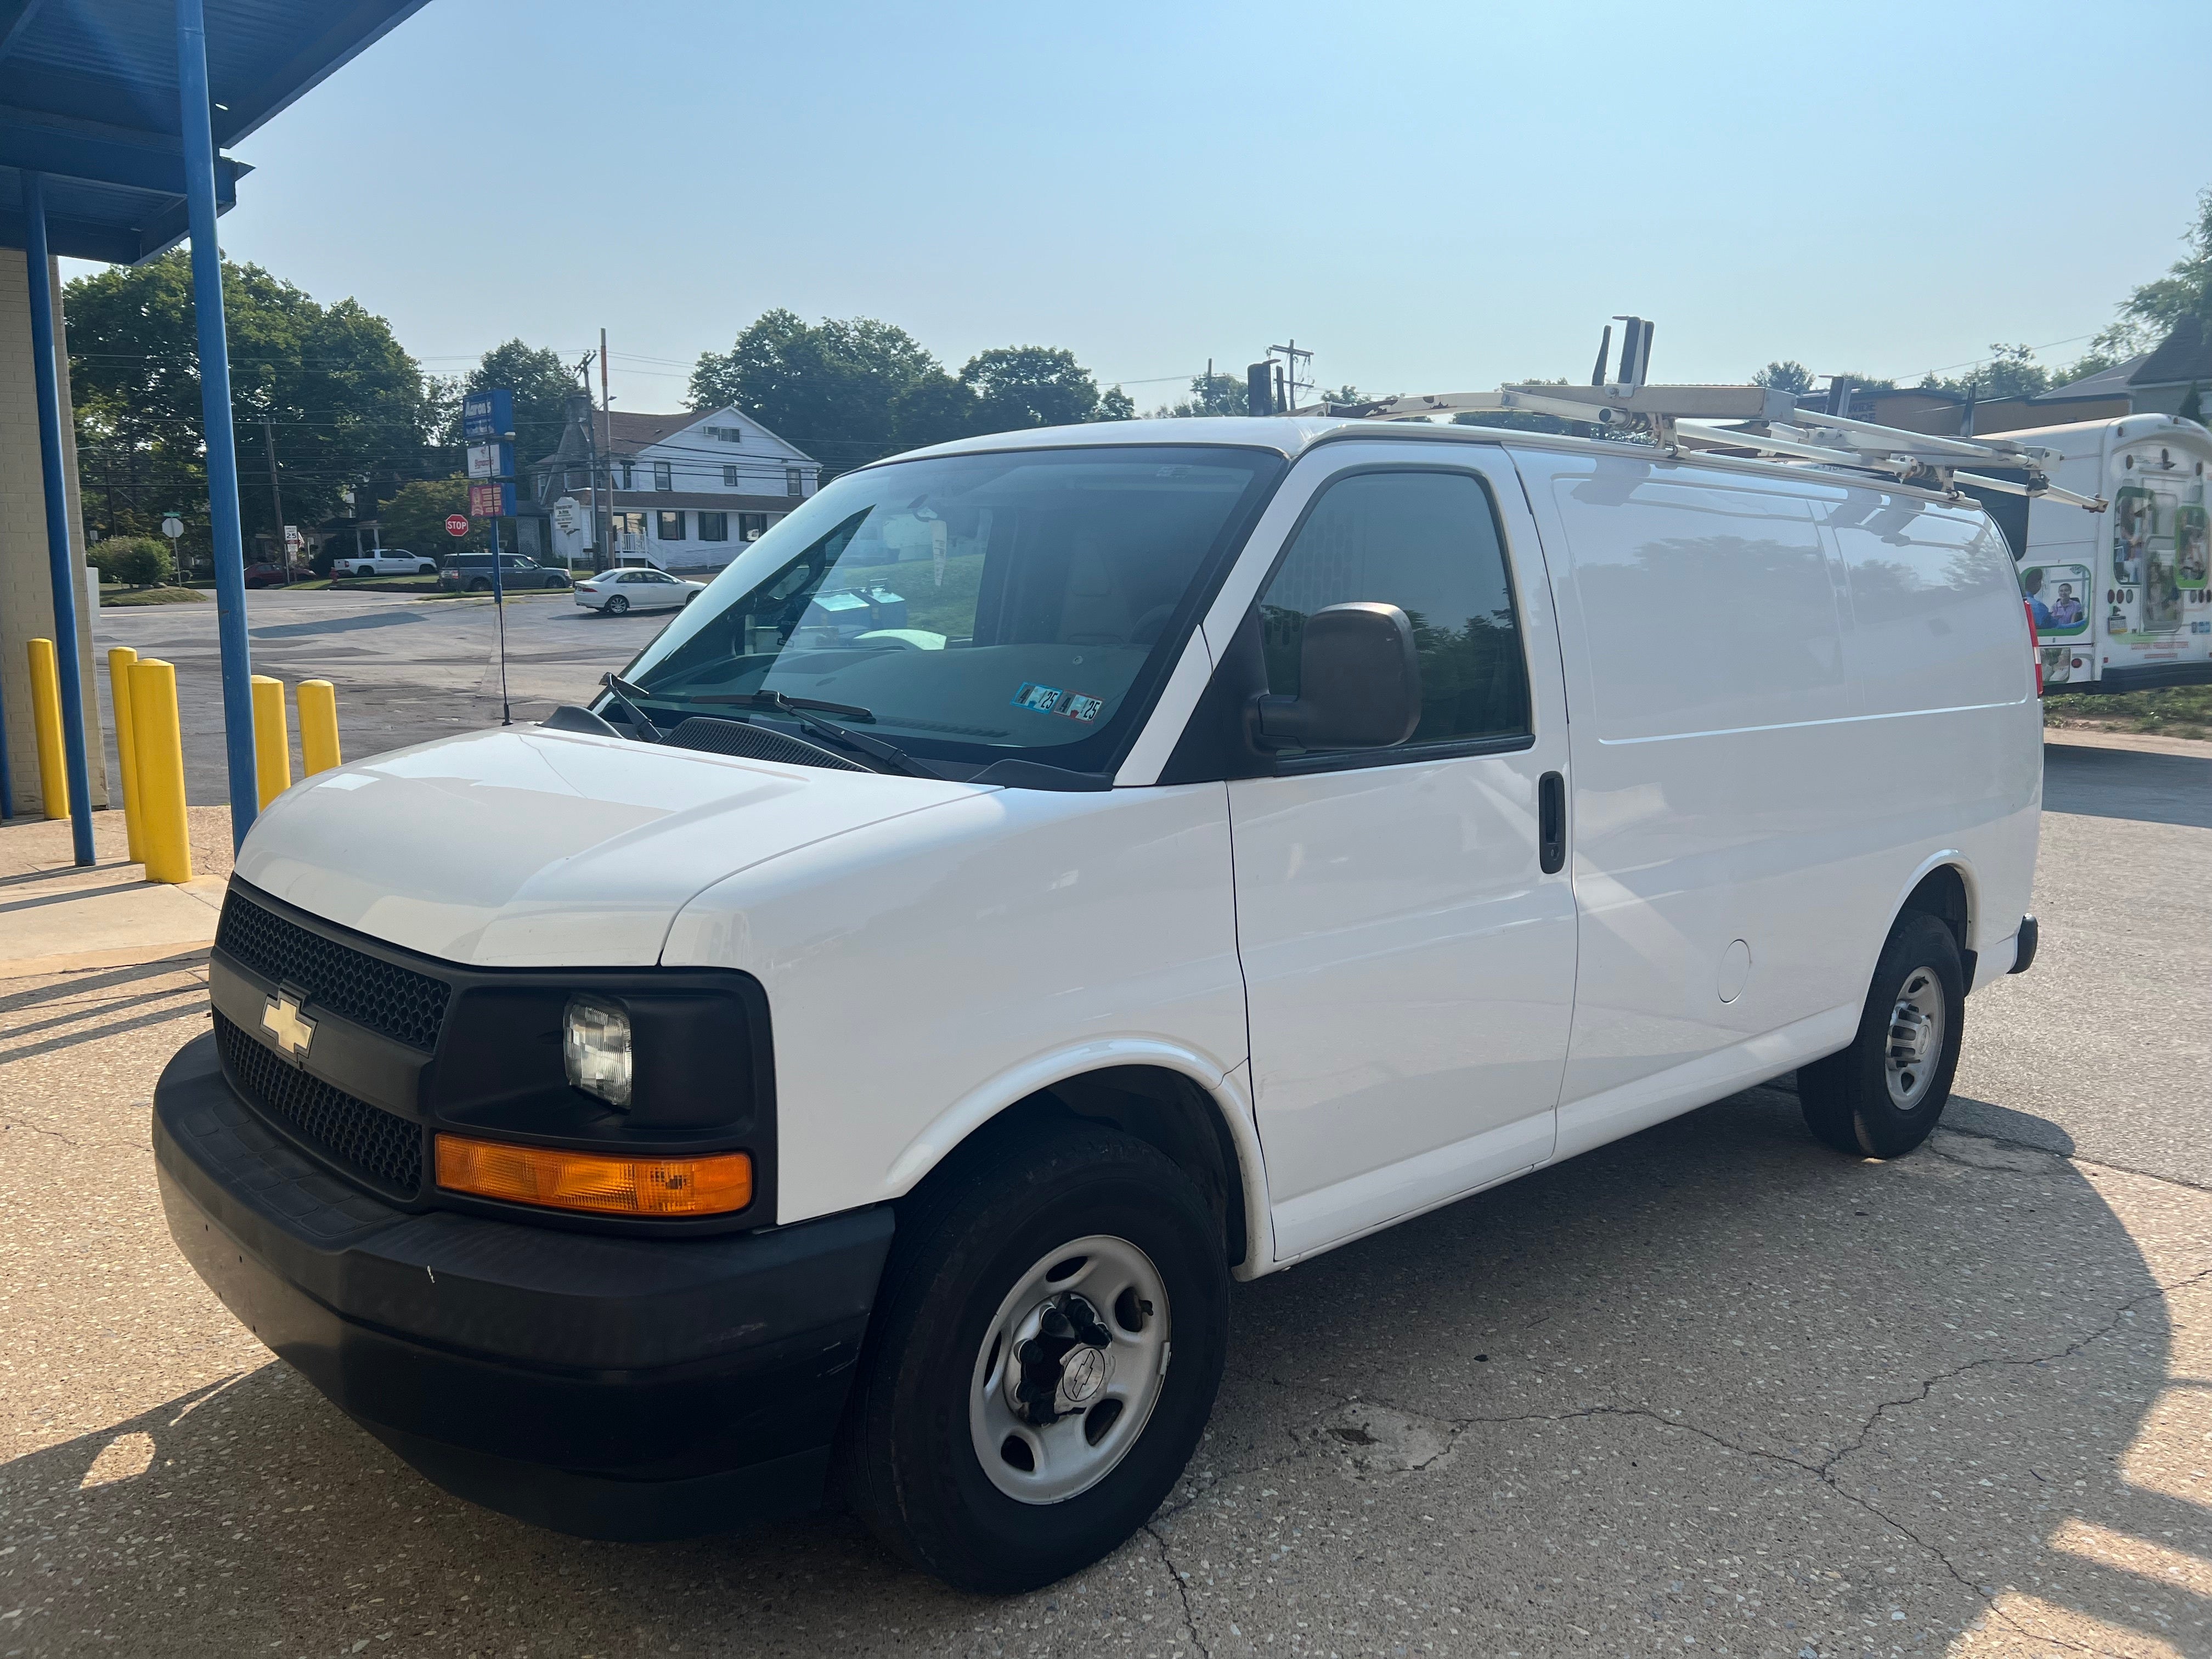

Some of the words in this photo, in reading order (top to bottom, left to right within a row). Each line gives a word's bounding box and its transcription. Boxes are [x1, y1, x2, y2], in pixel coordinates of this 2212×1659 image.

[447, 521, 466, 530] STOP
[1018, 689, 1030, 704] 4
[1040, 691, 1058, 709] 25
[1059, 697, 1071, 713] 4
[1083, 701, 1101, 719] 25
